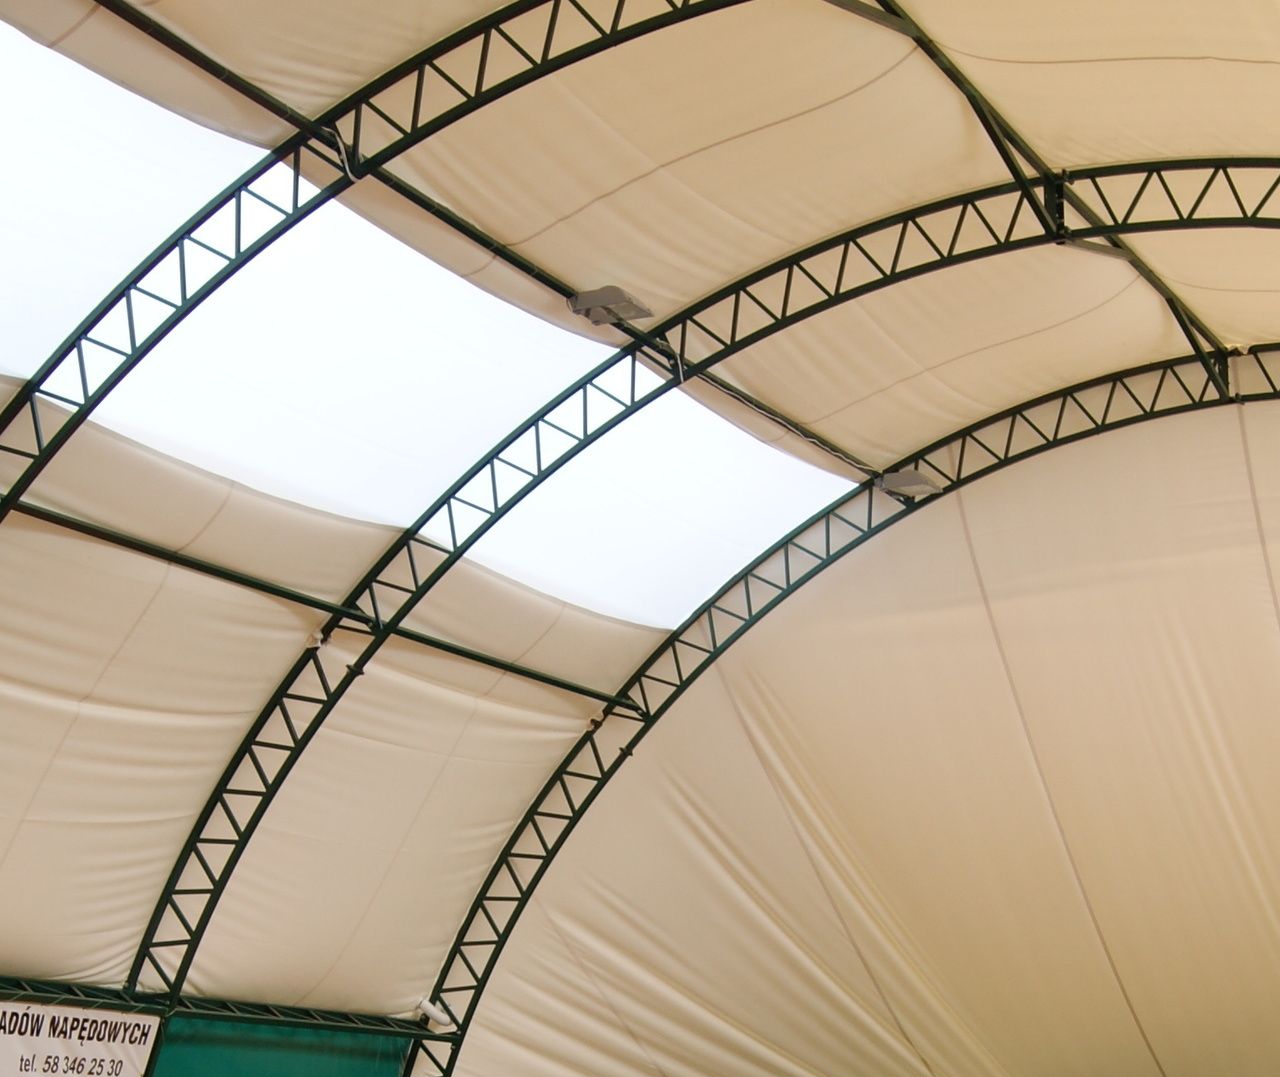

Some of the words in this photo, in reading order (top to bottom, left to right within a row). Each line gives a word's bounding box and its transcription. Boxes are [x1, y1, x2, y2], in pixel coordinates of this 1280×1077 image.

[48, 1015, 151, 1046] NAPĘDOWYCH
[19, 1054, 37, 1072] tel.
[43, 1055, 59, 1073] 58
[63, 1056, 86, 1075] 346
[88, 1058, 105, 1076] 25
[107, 1059, 123, 1077] 30
